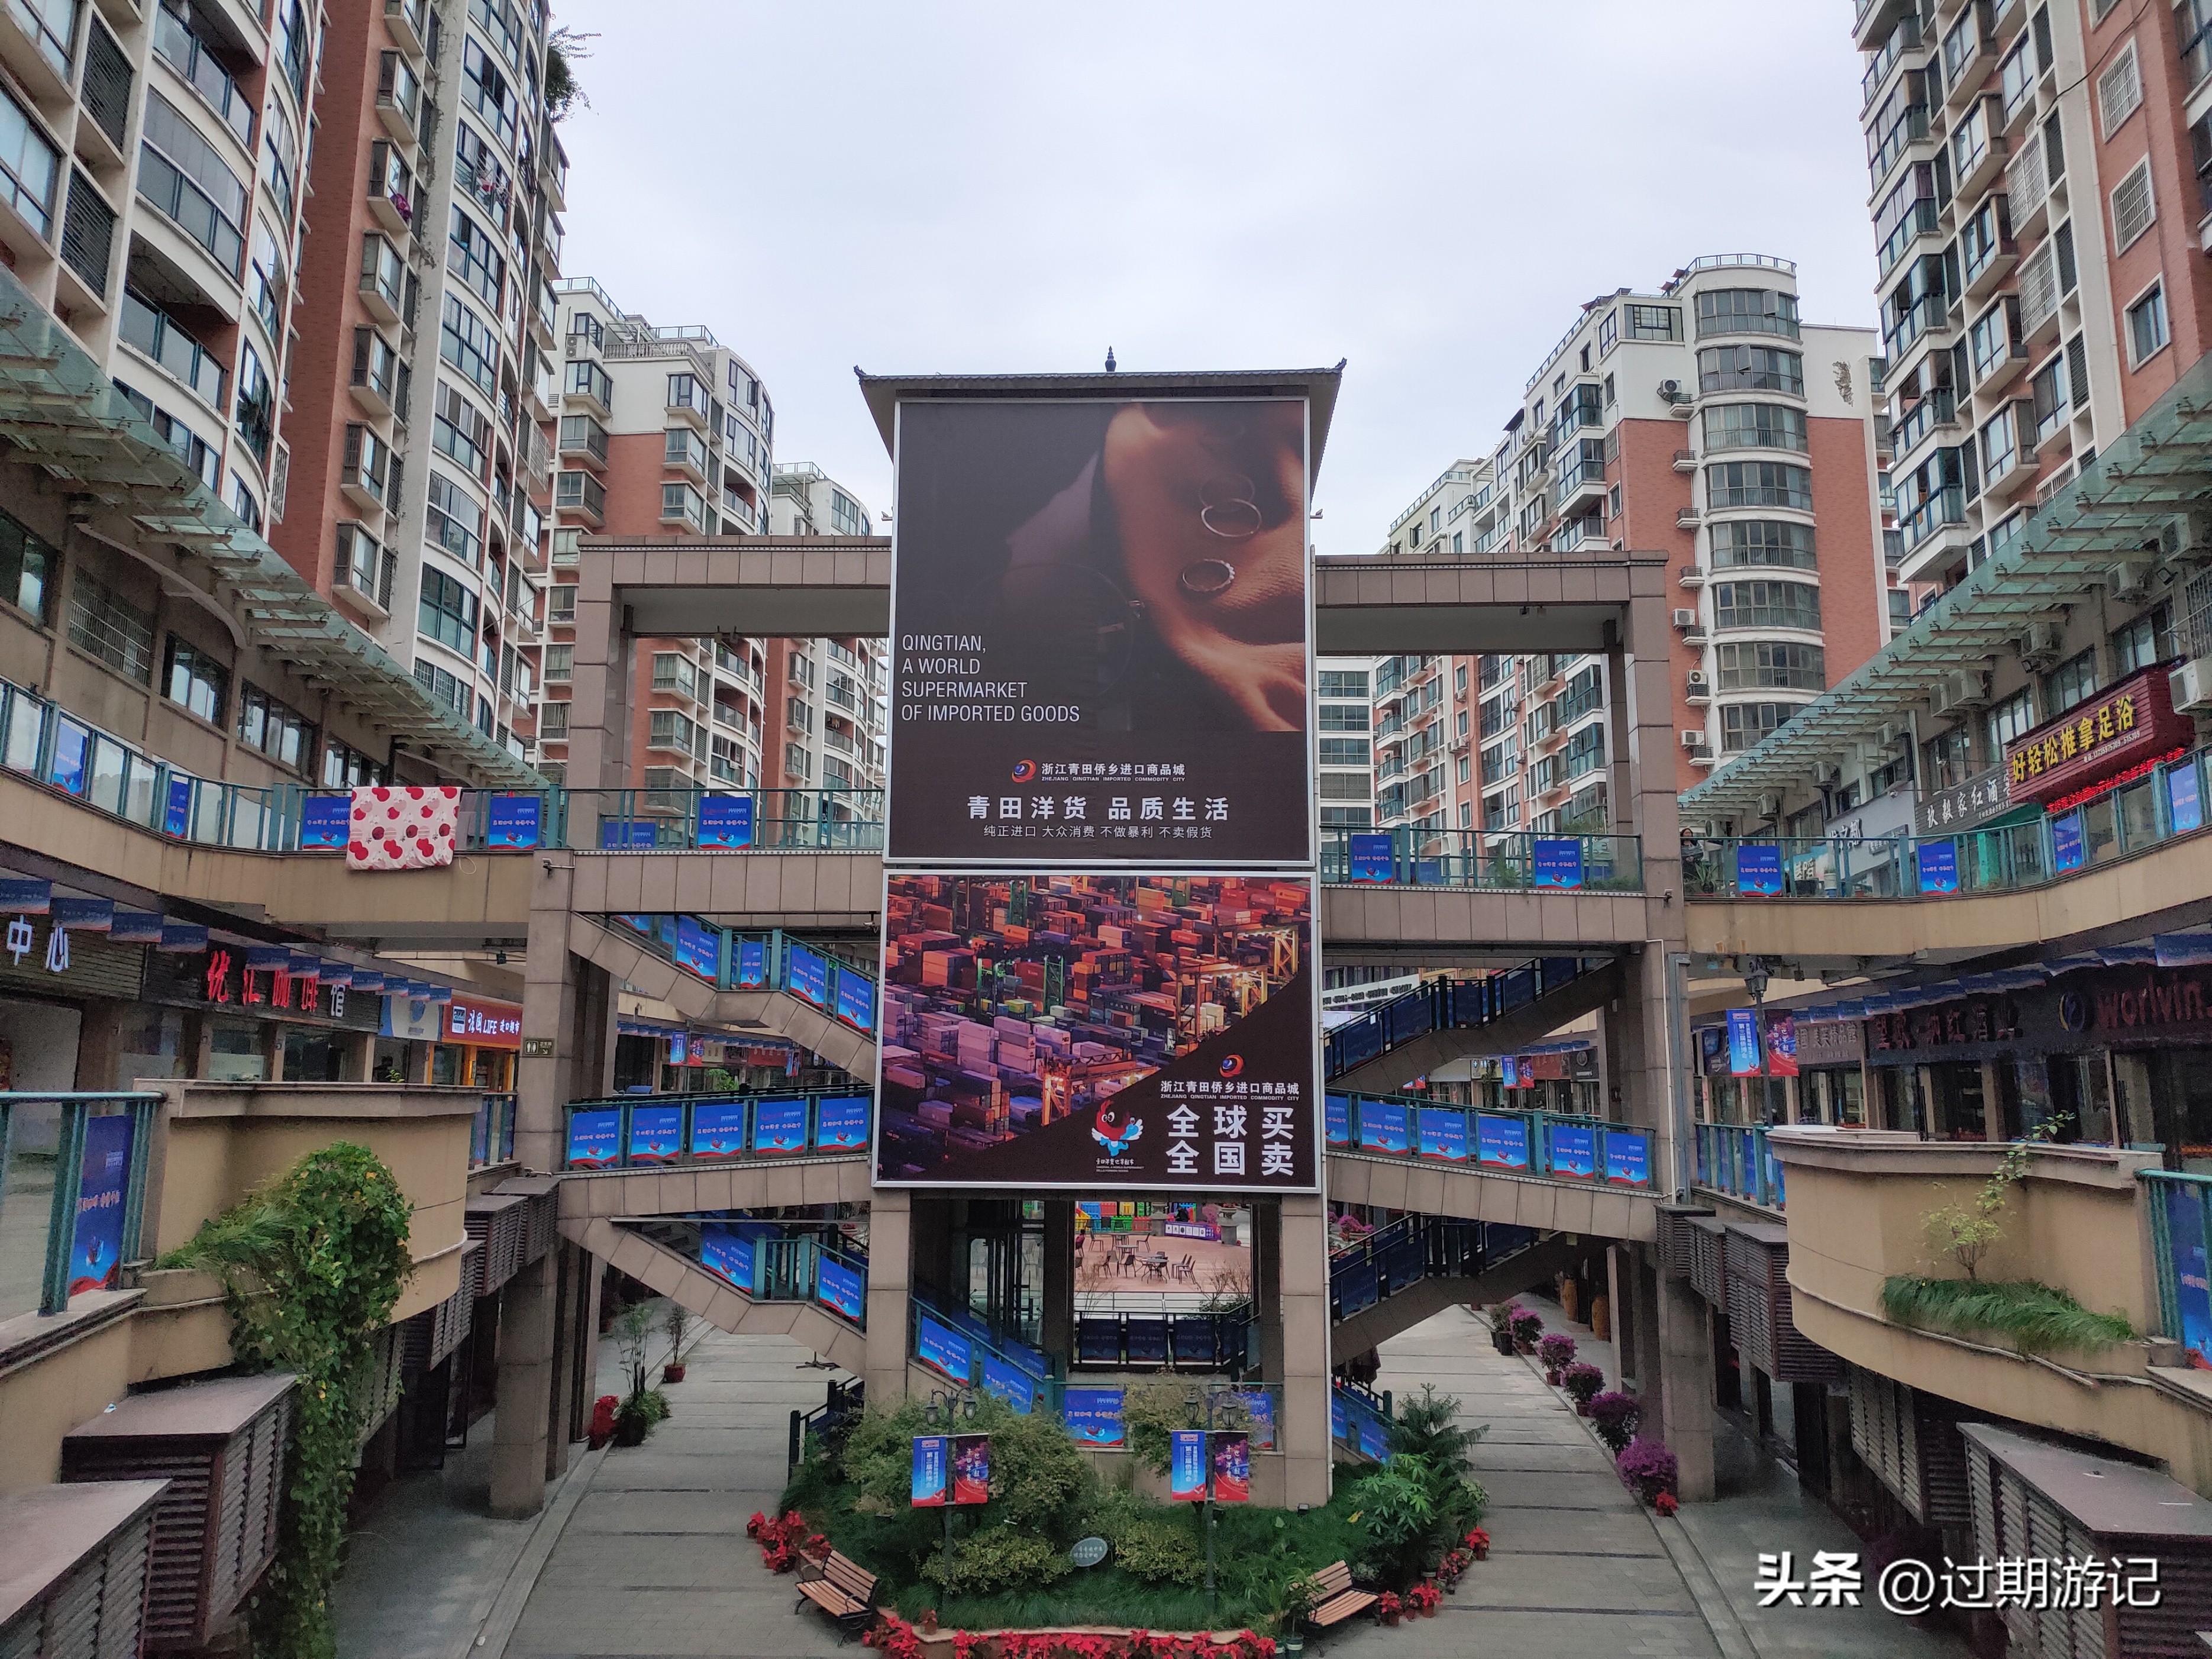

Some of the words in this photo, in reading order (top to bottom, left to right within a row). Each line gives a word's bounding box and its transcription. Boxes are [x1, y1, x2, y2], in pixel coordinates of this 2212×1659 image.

[902, 634, 986, 653] QINGTIAN,
[902, 658, 913, 674] A
[918, 658, 981, 674] WORLD
[902, 681, 1028, 698] SUPERMARKET
[902, 705, 923, 721] OF
[928, 705, 1015, 722] IMPORTED
[1021, 705, 1080, 722] GOODS
[2012, 693, 2137, 783] 好轻松推拿足浴
[1041, 762, 1186, 776] 浙江青田侨乡进口商品城
[967, 795, 1087, 820] 青田洋货
[1108, 796, 1229, 821] 品质生活
[983, 824, 1036, 838] 纯正进口
[1042, 825, 1095, 838] 大众消费
[1100, 825, 1154, 839] 不做暴利
[1159, 826, 1213, 839] 不卖假货
[1160, 1080, 1300, 1095] 浙江青田侨乡进口商品城
[1166, 1103, 1294, 1140] 全球买
[1165, 1140, 1294, 1176] 全国卖
